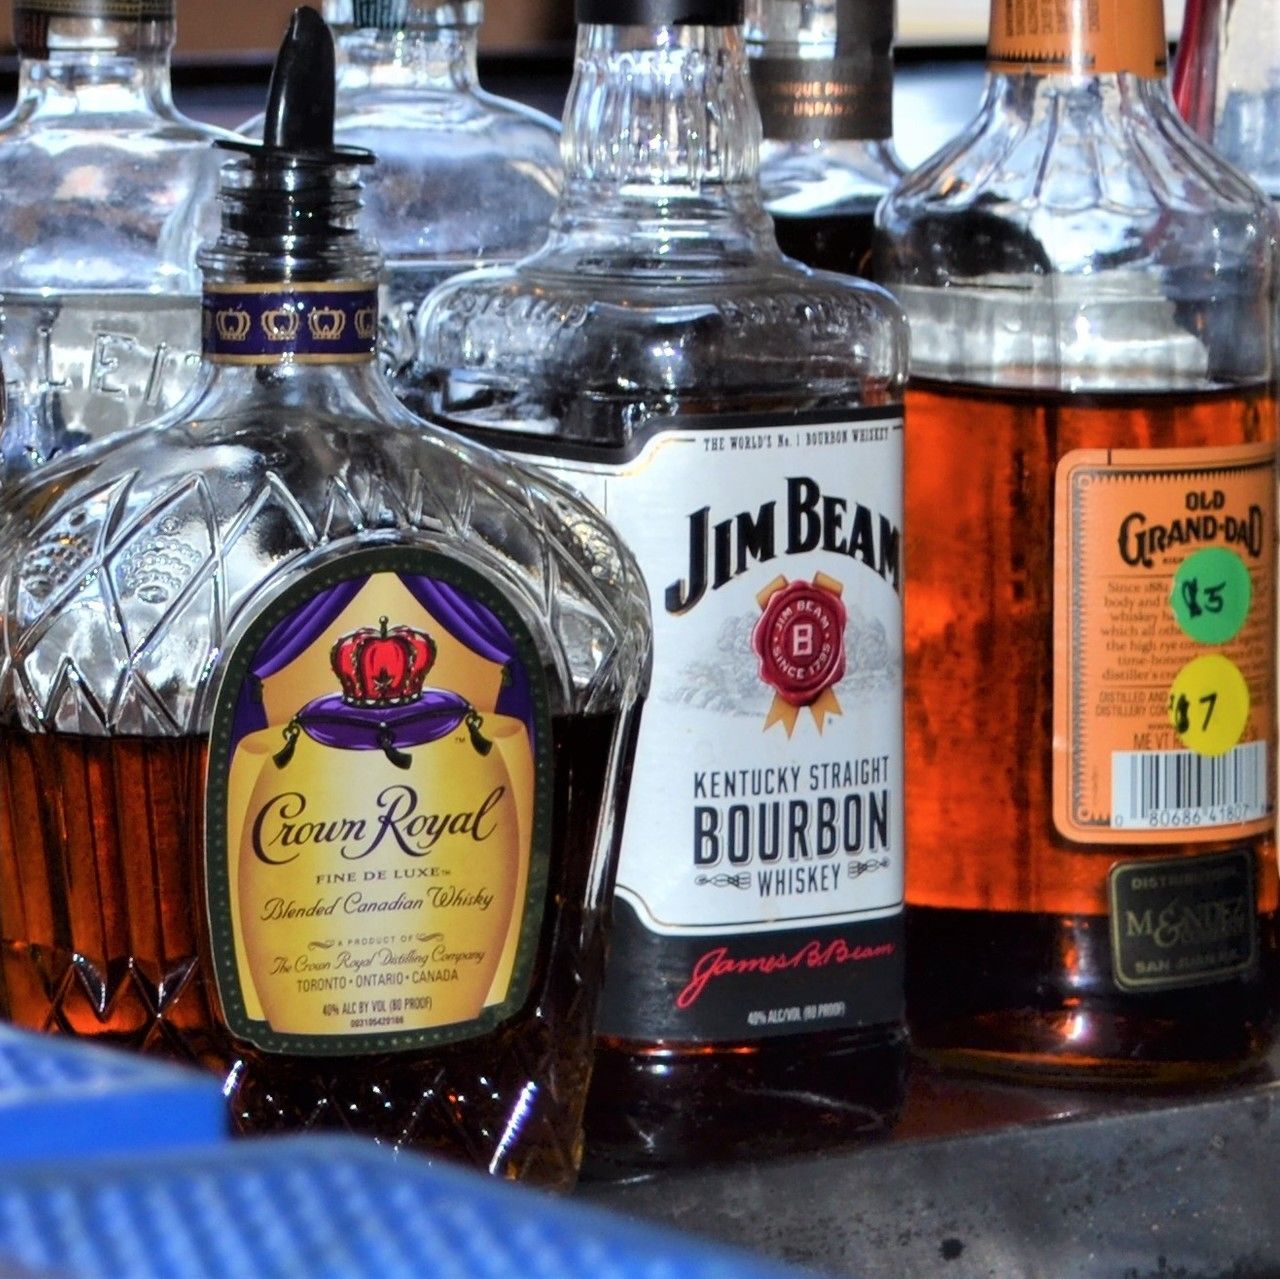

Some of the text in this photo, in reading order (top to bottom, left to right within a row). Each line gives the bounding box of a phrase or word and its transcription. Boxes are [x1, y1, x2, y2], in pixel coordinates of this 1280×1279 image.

[704, 427, 889, 452] THE WORLD'S No. BOURBON WHISKEY
[1185, 490, 1225, 511] OLD
[665, 476, 901, 617] JIM BEAM
[776, 600, 830, 631] JIM BEAM
[1105, 595, 1160, 613] body and
[793, 624, 812, 656] B
[1101, 625, 1138, 636] which
[1106, 640, 1126, 651] the
[772, 643, 831, 679] SINCE 1795
[1099, 691, 1169, 704] DISTILLED AND
[1095, 705, 1146, 717] DISTILLERY
[694, 756, 889, 799] KENTUCKY STRAIGHT
[252, 784, 506, 865] Crown Royal
[694, 789, 891, 869] BOURBON
[1148, 807, 1202, 826] 80686
[316, 874, 357, 885] FINE
[363, 871, 387, 881] DE
[757, 863, 841, 897] WHISKEY
[260, 885, 496, 922] Blended Canadian Whisky
[347, 936, 396, 946] PRODUCT
[400, 934, 414, 943] OF
[269, 944, 487, 976] The Crown Royal Distilling Company
[296, 969, 459, 993] TORONTO ONTARIO CANADA
[676, 938, 896, 1009] James Beam
[322, 996, 433, 1017] 40% ALC BY VOL PROOF)
